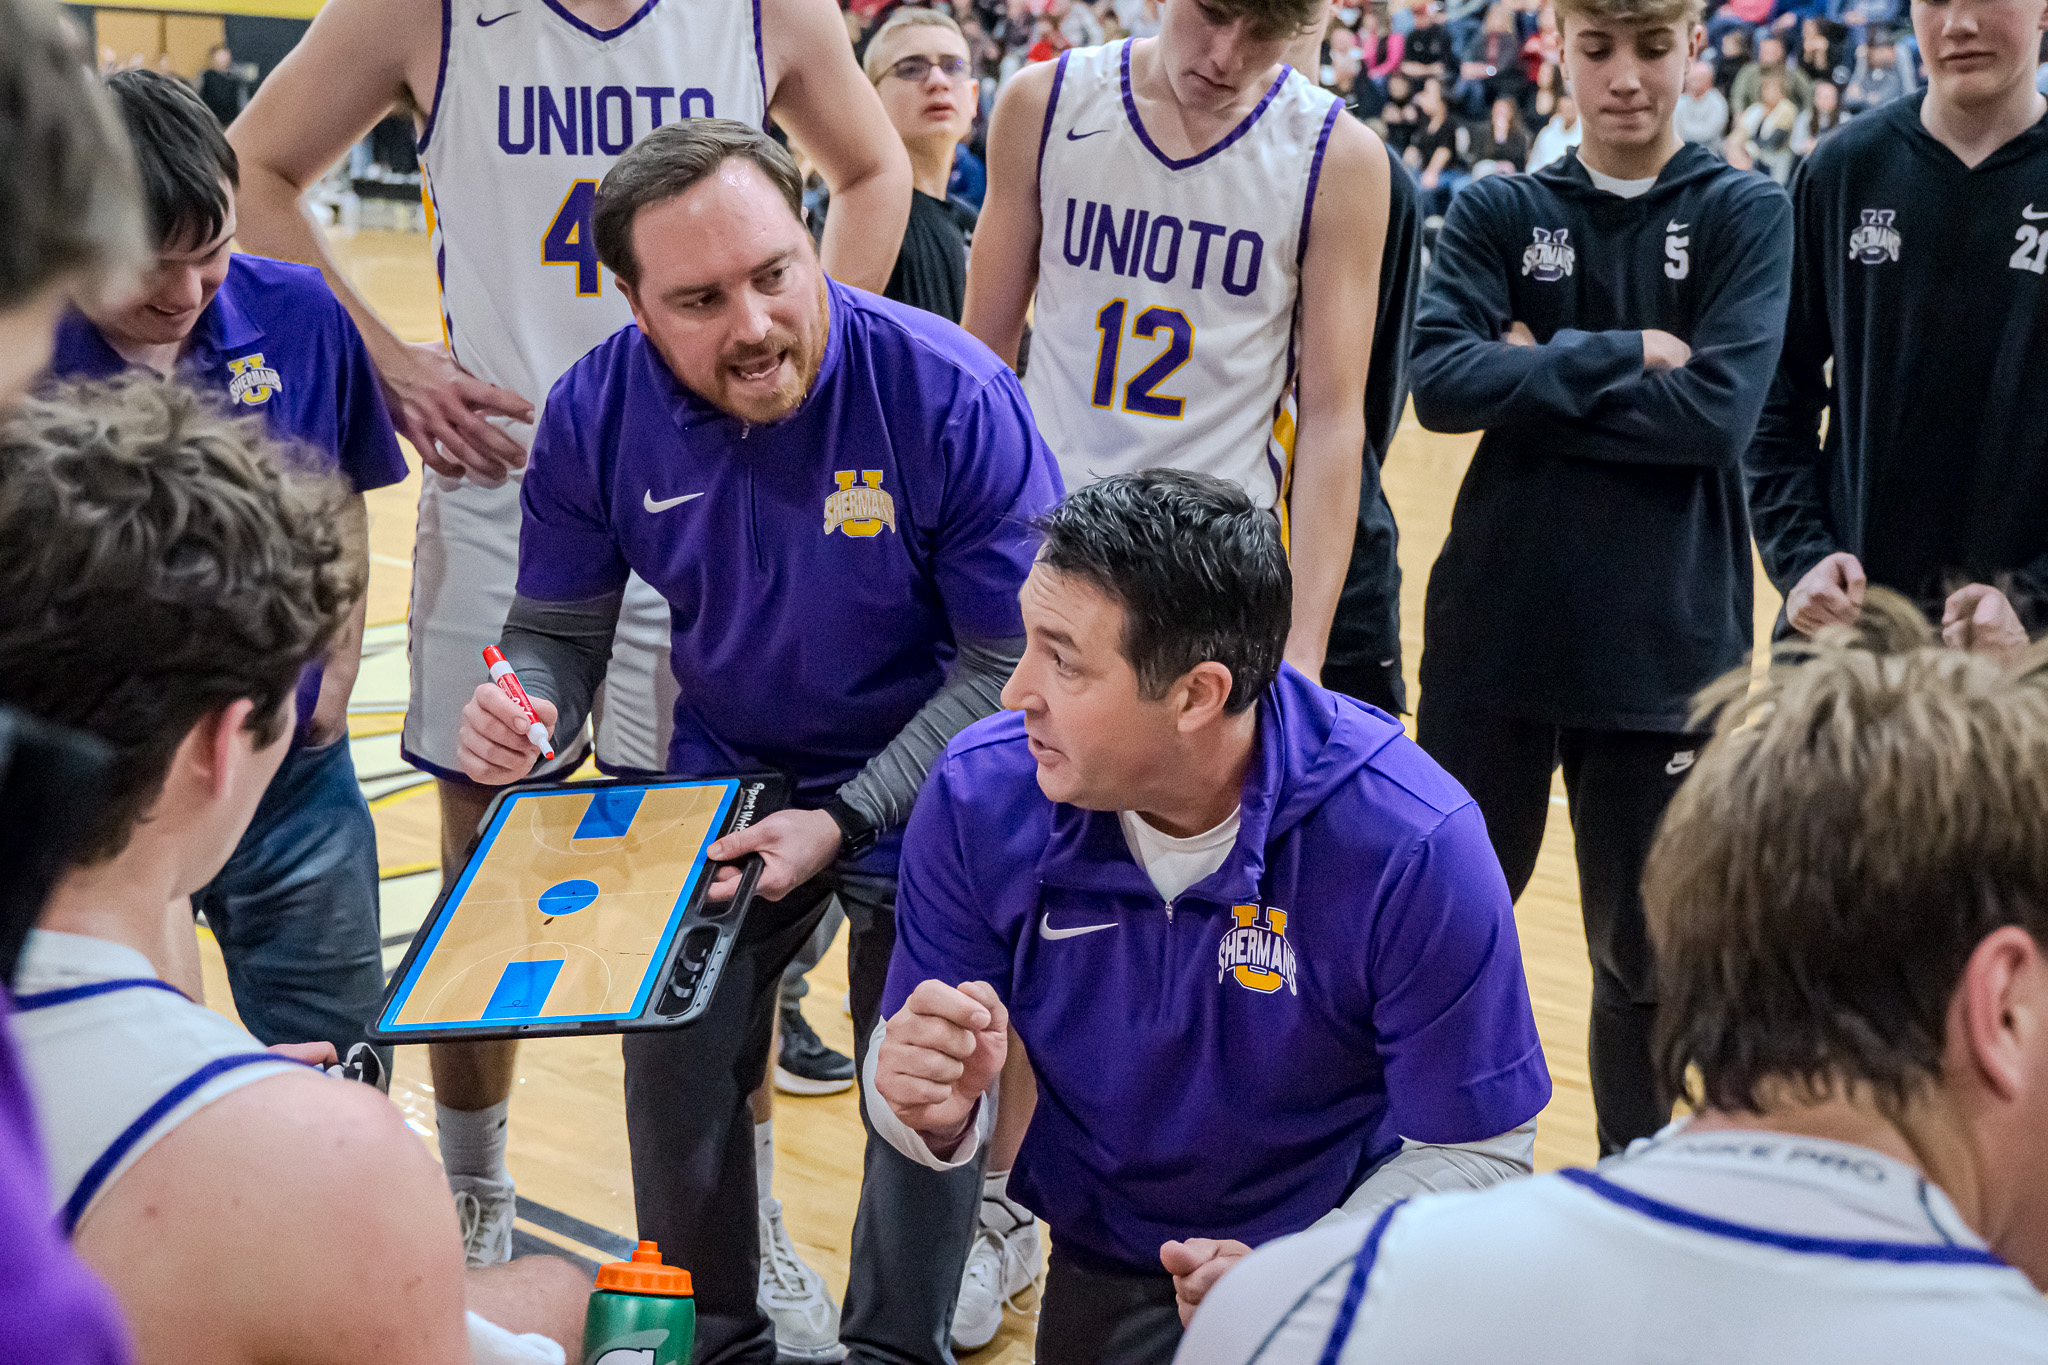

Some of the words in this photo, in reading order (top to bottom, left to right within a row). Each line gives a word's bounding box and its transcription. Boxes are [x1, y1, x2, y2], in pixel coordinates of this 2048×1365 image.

[540, 178, 604, 298] 4
[1062, 197, 1264, 297] UNIOTO
[1664, 235, 1690, 280] 5
[1091, 297, 1196, 421] 12
[834, 469, 884, 538] U
[743, 782, 765, 810] Sport
[1218, 928, 1297, 997] SHERMANS
[1231, 902, 1288, 994] U
